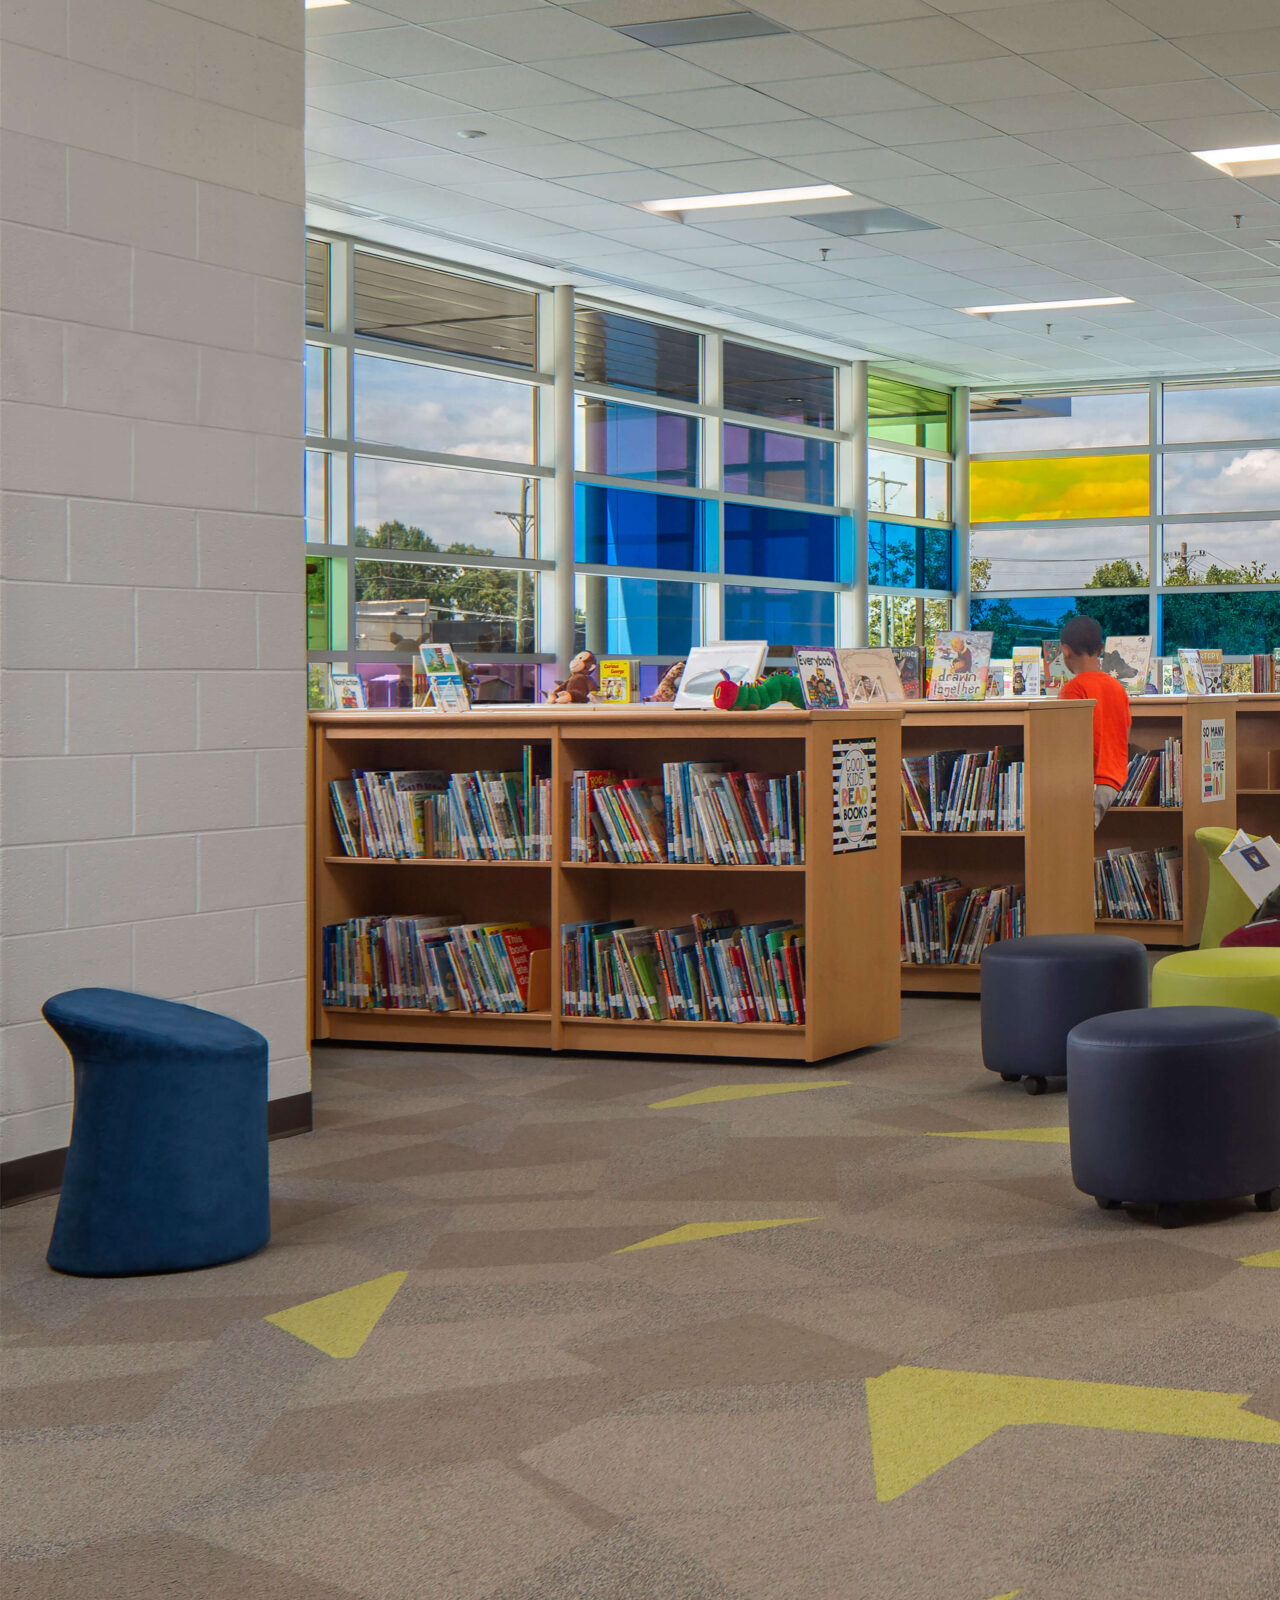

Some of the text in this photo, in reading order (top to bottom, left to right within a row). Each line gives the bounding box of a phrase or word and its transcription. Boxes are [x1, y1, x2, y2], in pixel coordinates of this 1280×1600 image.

[798, 654, 835, 668] Everybody
[938, 668, 977, 682] drawn
[933, 681, 980, 698] together
[1203, 726, 1224, 737] SO MANY
[845, 757, 865, 772] COOL
[1212, 760, 1224, 771] TIME
[846, 772, 864, 787] KIDS
[841, 786, 868, 806] READ
[843, 805, 868, 820] BOOKS
[505, 935, 523, 945] This
[509, 944, 529, 955] book
[512, 954, 528, 967] just
